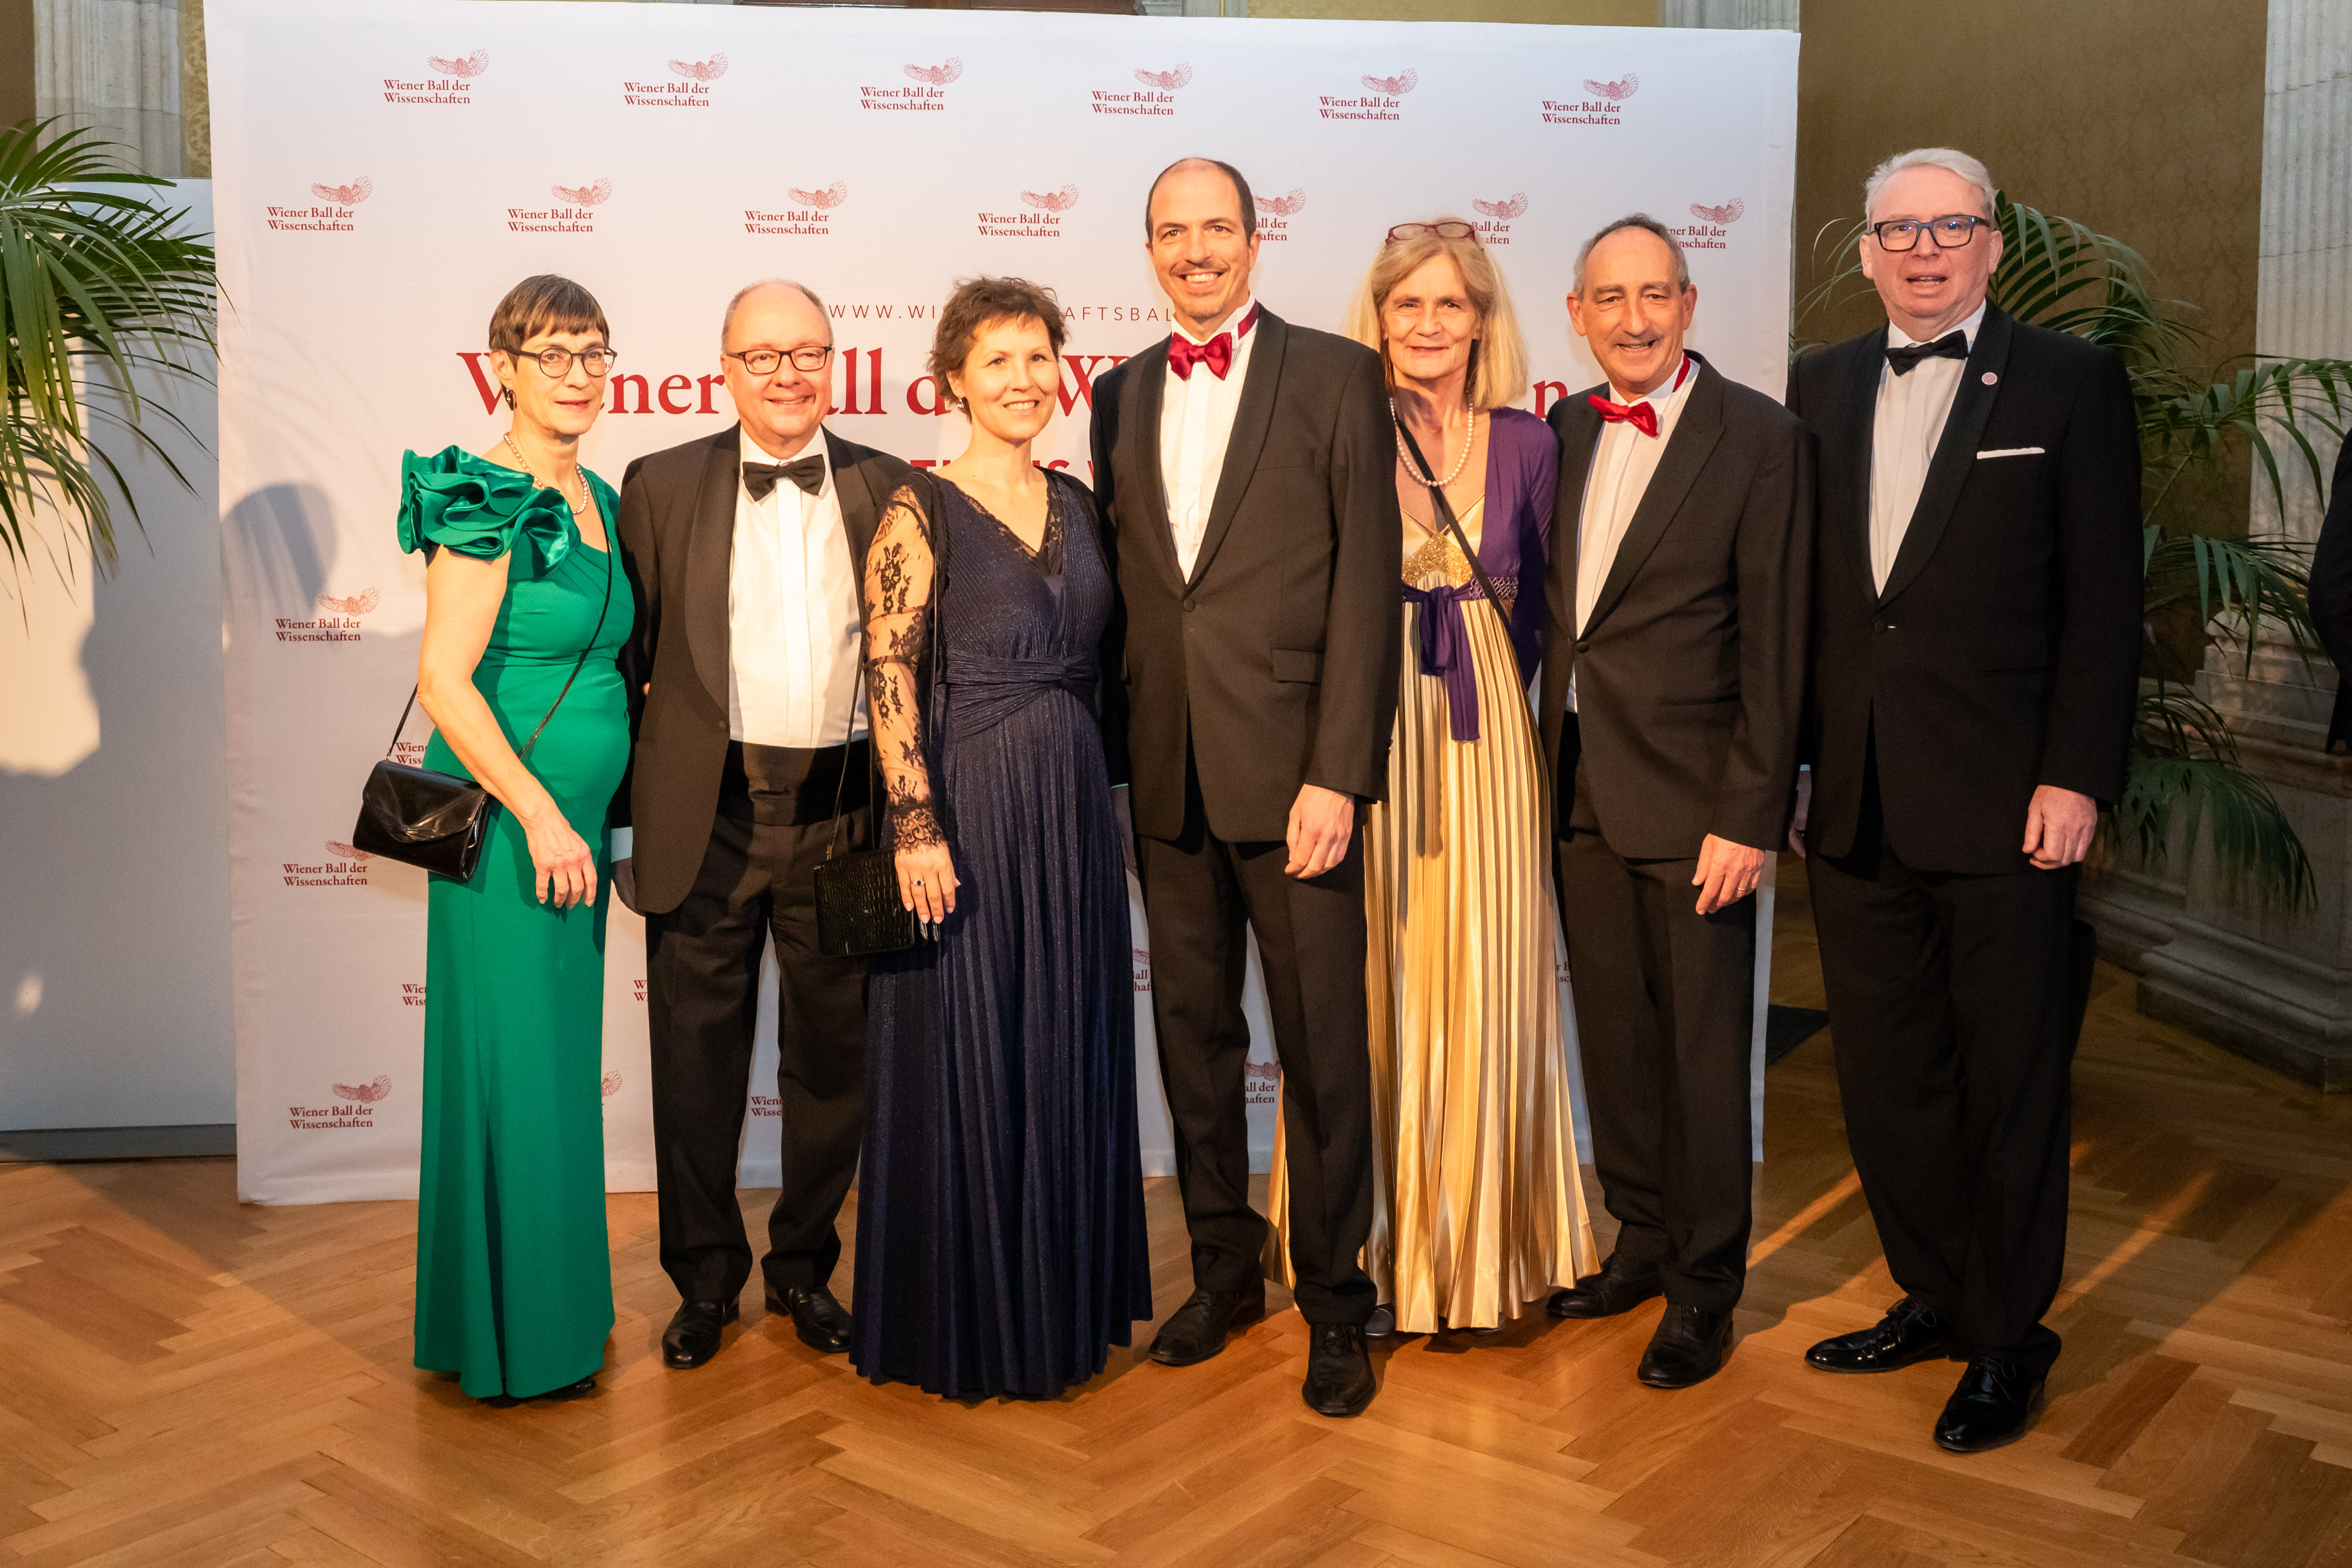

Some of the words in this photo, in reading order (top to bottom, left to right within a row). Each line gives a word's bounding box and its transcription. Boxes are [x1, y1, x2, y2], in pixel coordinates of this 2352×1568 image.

[383, 79, 425, 91] Wiener
[427, 79, 449, 91] Ball
[452, 79, 470, 91] der
[624, 82, 664, 93] Wiener
[667, 82, 689, 93] Ball
[691, 82, 710, 93] der
[383, 92, 470, 104] Wissenschaften
[860, 86, 900, 97] Wiener
[903, 86, 924, 98] Ball
[926, 86, 944, 98] der
[1091, 91, 1131, 102] Wiener
[1133, 91, 1154, 102] Ball
[1156, 92, 1174, 103] der
[624, 95, 709, 106] Wissenschaften
[860, 99, 944, 111] Wissenschaften
[1319, 96, 1358, 107] Wiener
[1360, 96, 1381, 108] Ball
[1382, 97, 1400, 108] der
[1542, 101, 1580, 112] Wiener
[1581, 101, 1602, 112] Ball
[1603, 102, 1621, 112] der
[1091, 103, 1174, 115] Wissenschaften
[1319, 109, 1399, 120] Wissenschaften
[1542, 113, 1621, 125] Wissenschaften
[266, 206, 309, 218] Wiener
[310, 206, 333, 218] Ball
[335, 206, 354, 218] der
[507, 209, 549, 219] Wiener
[550, 208, 573, 219] Ball
[575, 208, 593, 219] der
[744, 210, 785, 221] Wiener
[787, 210, 808, 222] Ball
[811, 210, 829, 222] der
[977, 213, 1017, 223] Wiener
[1020, 213, 1040, 224] Ball
[1043, 213, 1060, 224] der
[1255, 217, 1268, 229] all
[1270, 218, 1288, 229] der
[267, 219, 354, 231] Wissenschaften
[507, 221, 593, 232] Wissenschaften
[744, 223, 828, 235] Wissenschaften
[1493, 221, 1511, 232] der
[1688, 225, 1708, 236] Ball
[1710, 226, 1727, 237] der
[978, 226, 1060, 237] Wissenschaften
[1679, 238, 1726, 249] nschaften
[275, 618, 316, 629] Wiener
[318, 618, 340, 628] Ball
[343, 618, 360, 628] der
[275, 630, 361, 641] Wissenschaften
[395, 742, 427, 752] Wien
[282, 864, 323, 874] Wiener
[325, 862, 347, 874] Ball
[349, 862, 368, 873] der
[283, 874, 368, 887] Wissenschaften
[1133, 969, 1148, 979] all
[402, 984, 427, 994] Wie
[1245, 1081, 1257, 1092] all
[1258, 1081, 1276, 1092] der
[750, 1096, 783, 1106] Wien
[289, 1106, 329, 1117] Wiener
[331, 1105, 353, 1116] Ball
[355, 1105, 373, 1115] der
[289, 1116, 373, 1129] Wissenschaften
